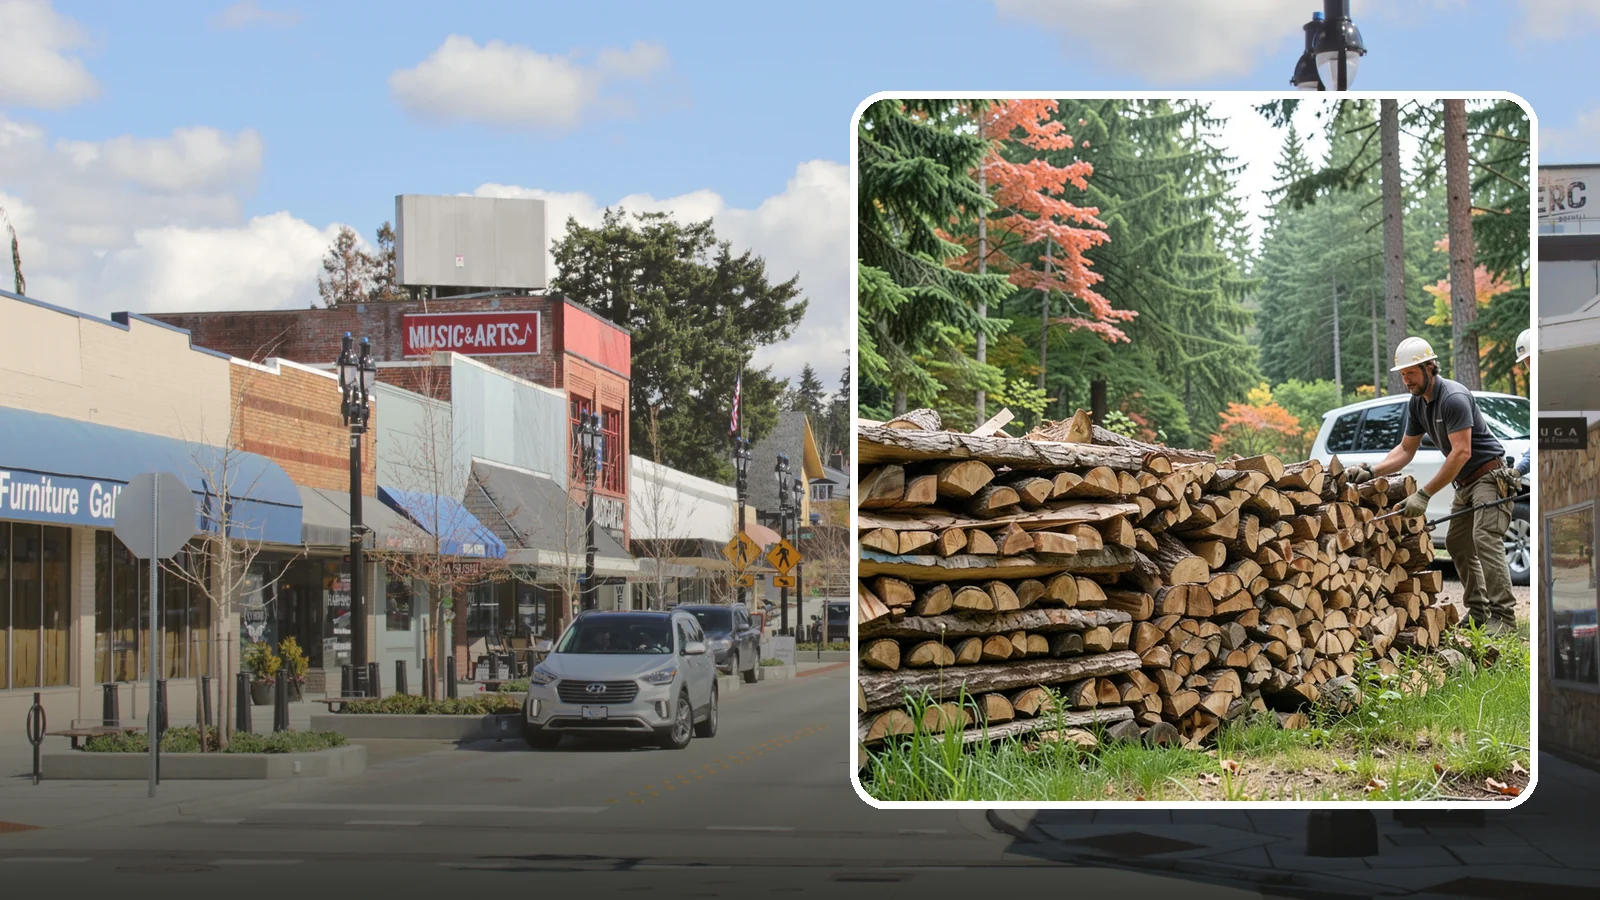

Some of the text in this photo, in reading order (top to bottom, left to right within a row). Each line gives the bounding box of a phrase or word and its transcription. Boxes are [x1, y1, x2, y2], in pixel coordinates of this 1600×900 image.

[409, 323, 519, 349] MUSIC&ARTS
[0, 471, 121, 519] Furniture Gal
